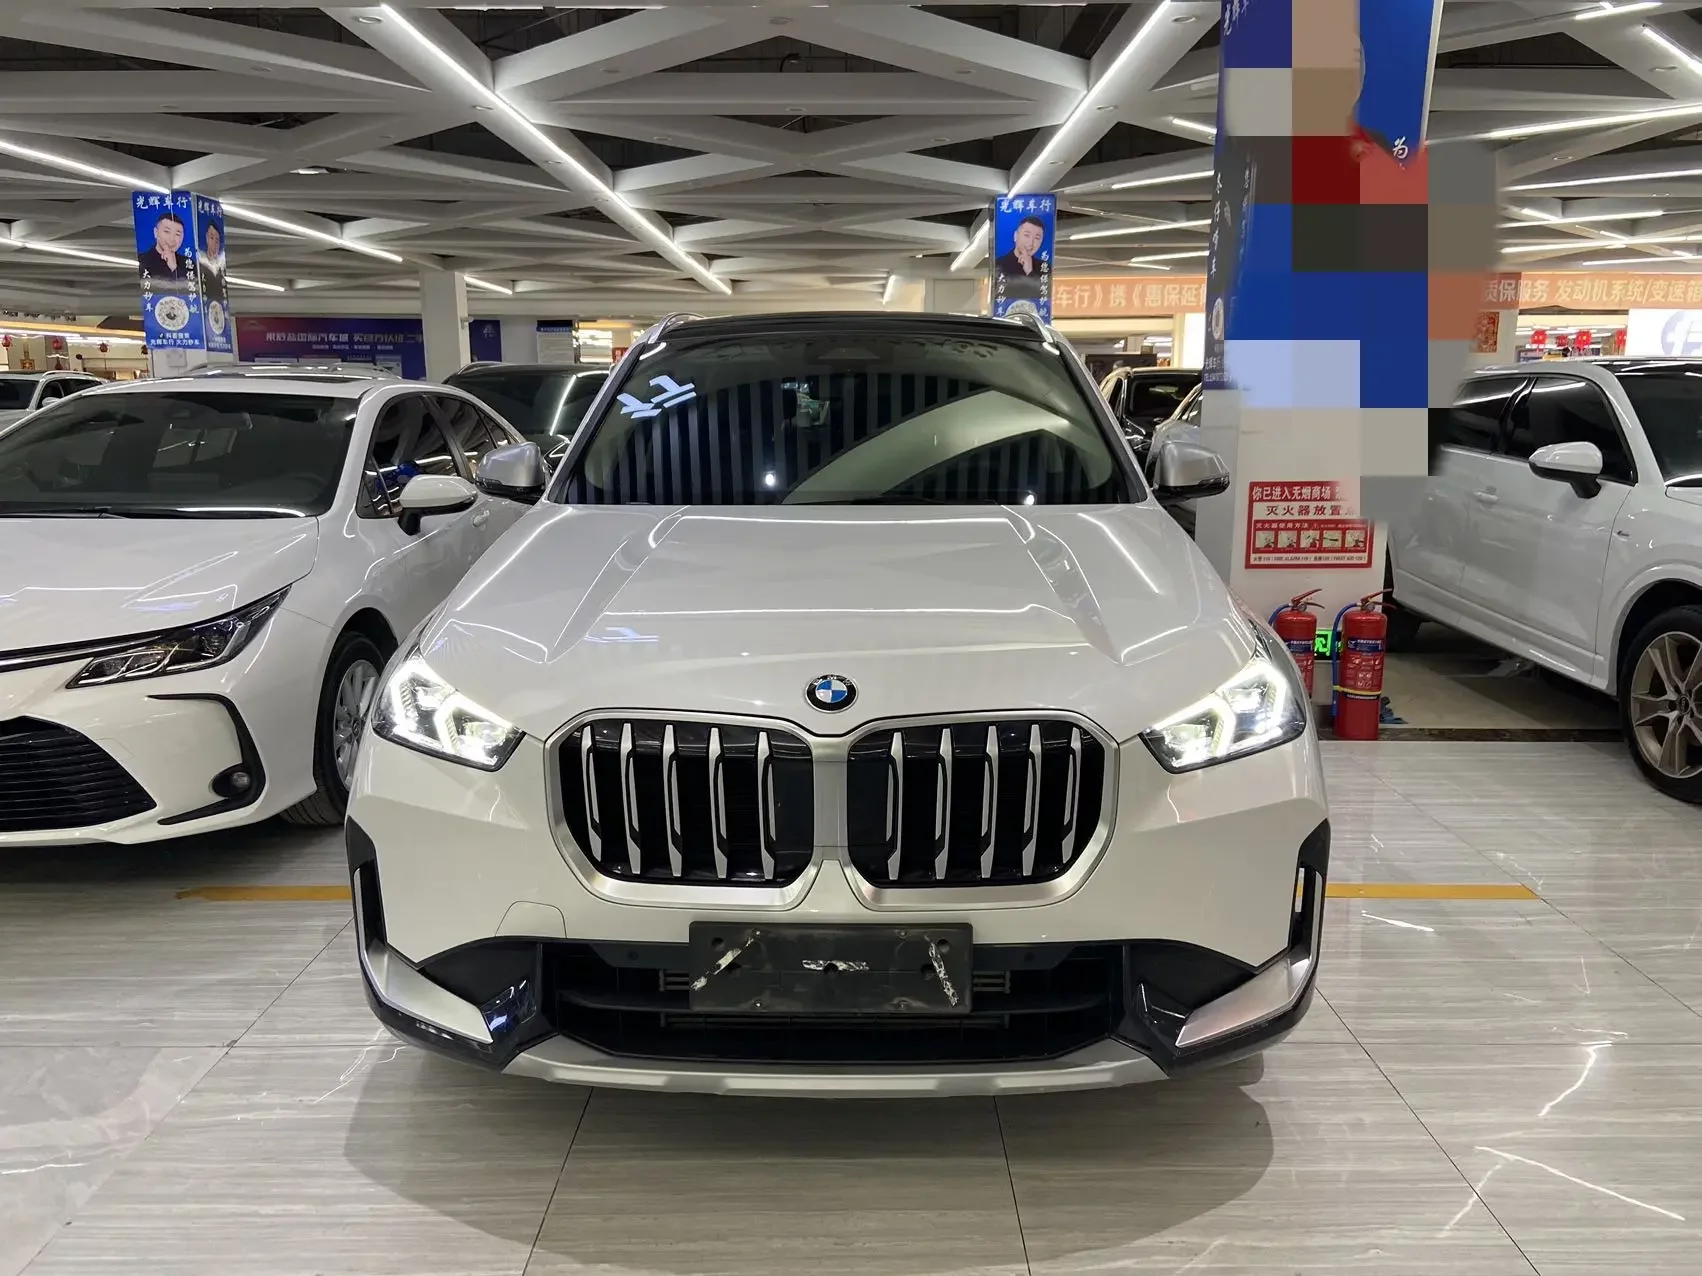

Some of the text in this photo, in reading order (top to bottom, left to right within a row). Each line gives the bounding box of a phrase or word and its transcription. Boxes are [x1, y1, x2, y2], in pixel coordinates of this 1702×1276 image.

[136, 195, 188, 210] 光辉车行
[1000, 199, 1051, 213] 光辉车行
[1052, 284, 1206, 307] 车行》携《惠保延
[1252, 486, 1331, 500] 你已进入无烟商场
